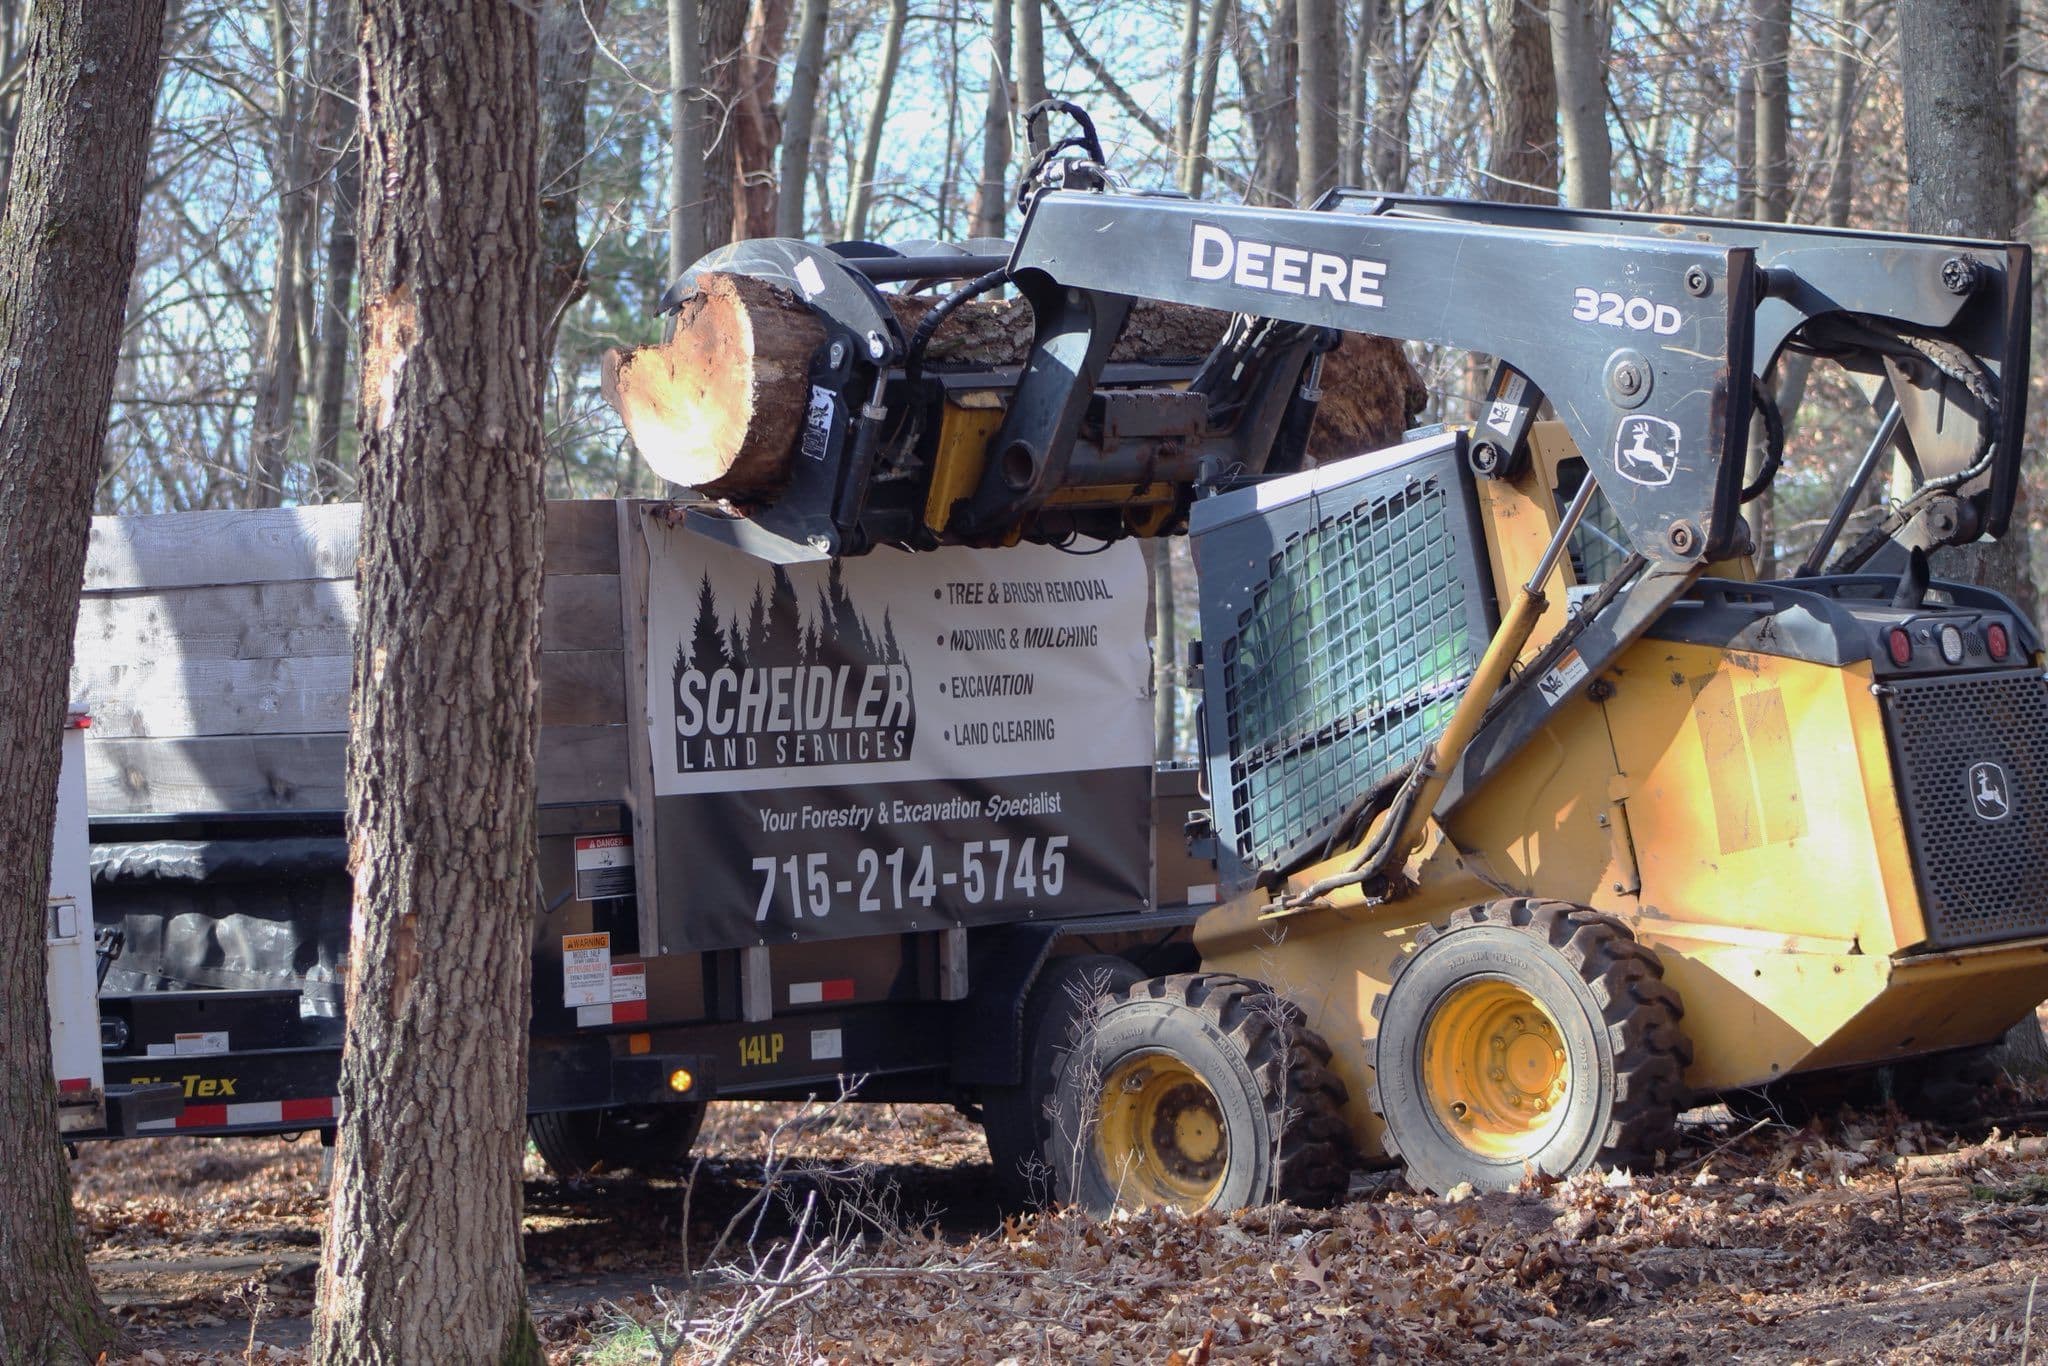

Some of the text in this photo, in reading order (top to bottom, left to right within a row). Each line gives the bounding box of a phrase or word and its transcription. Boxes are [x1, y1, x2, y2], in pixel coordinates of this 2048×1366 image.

[1190, 224, 1387, 308] DEERE
[1572, 287, 1682, 335] 320D
[946, 579, 1113, 605] TREE & BRUSH REMOVAL
[951, 625, 1098, 651] MOWING & MULCHING
[677, 664, 910, 737] SCHEIDLER
[951, 673, 1034, 699] EXCAVATION
[954, 719, 1055, 746] LAND CLEARING
[683, 730, 905, 769] LAND SERVICES
[760, 792, 1062, 833] Your Forestry & Excavation Specialist
[596, 838, 624, 849] DANGER
[752, 835, 1069, 922] 715-214-5745
[574, 936, 606, 949] WARNING
[738, 1033, 784, 1066] 14LP
[182, 1074, 238, 1098] Tex
